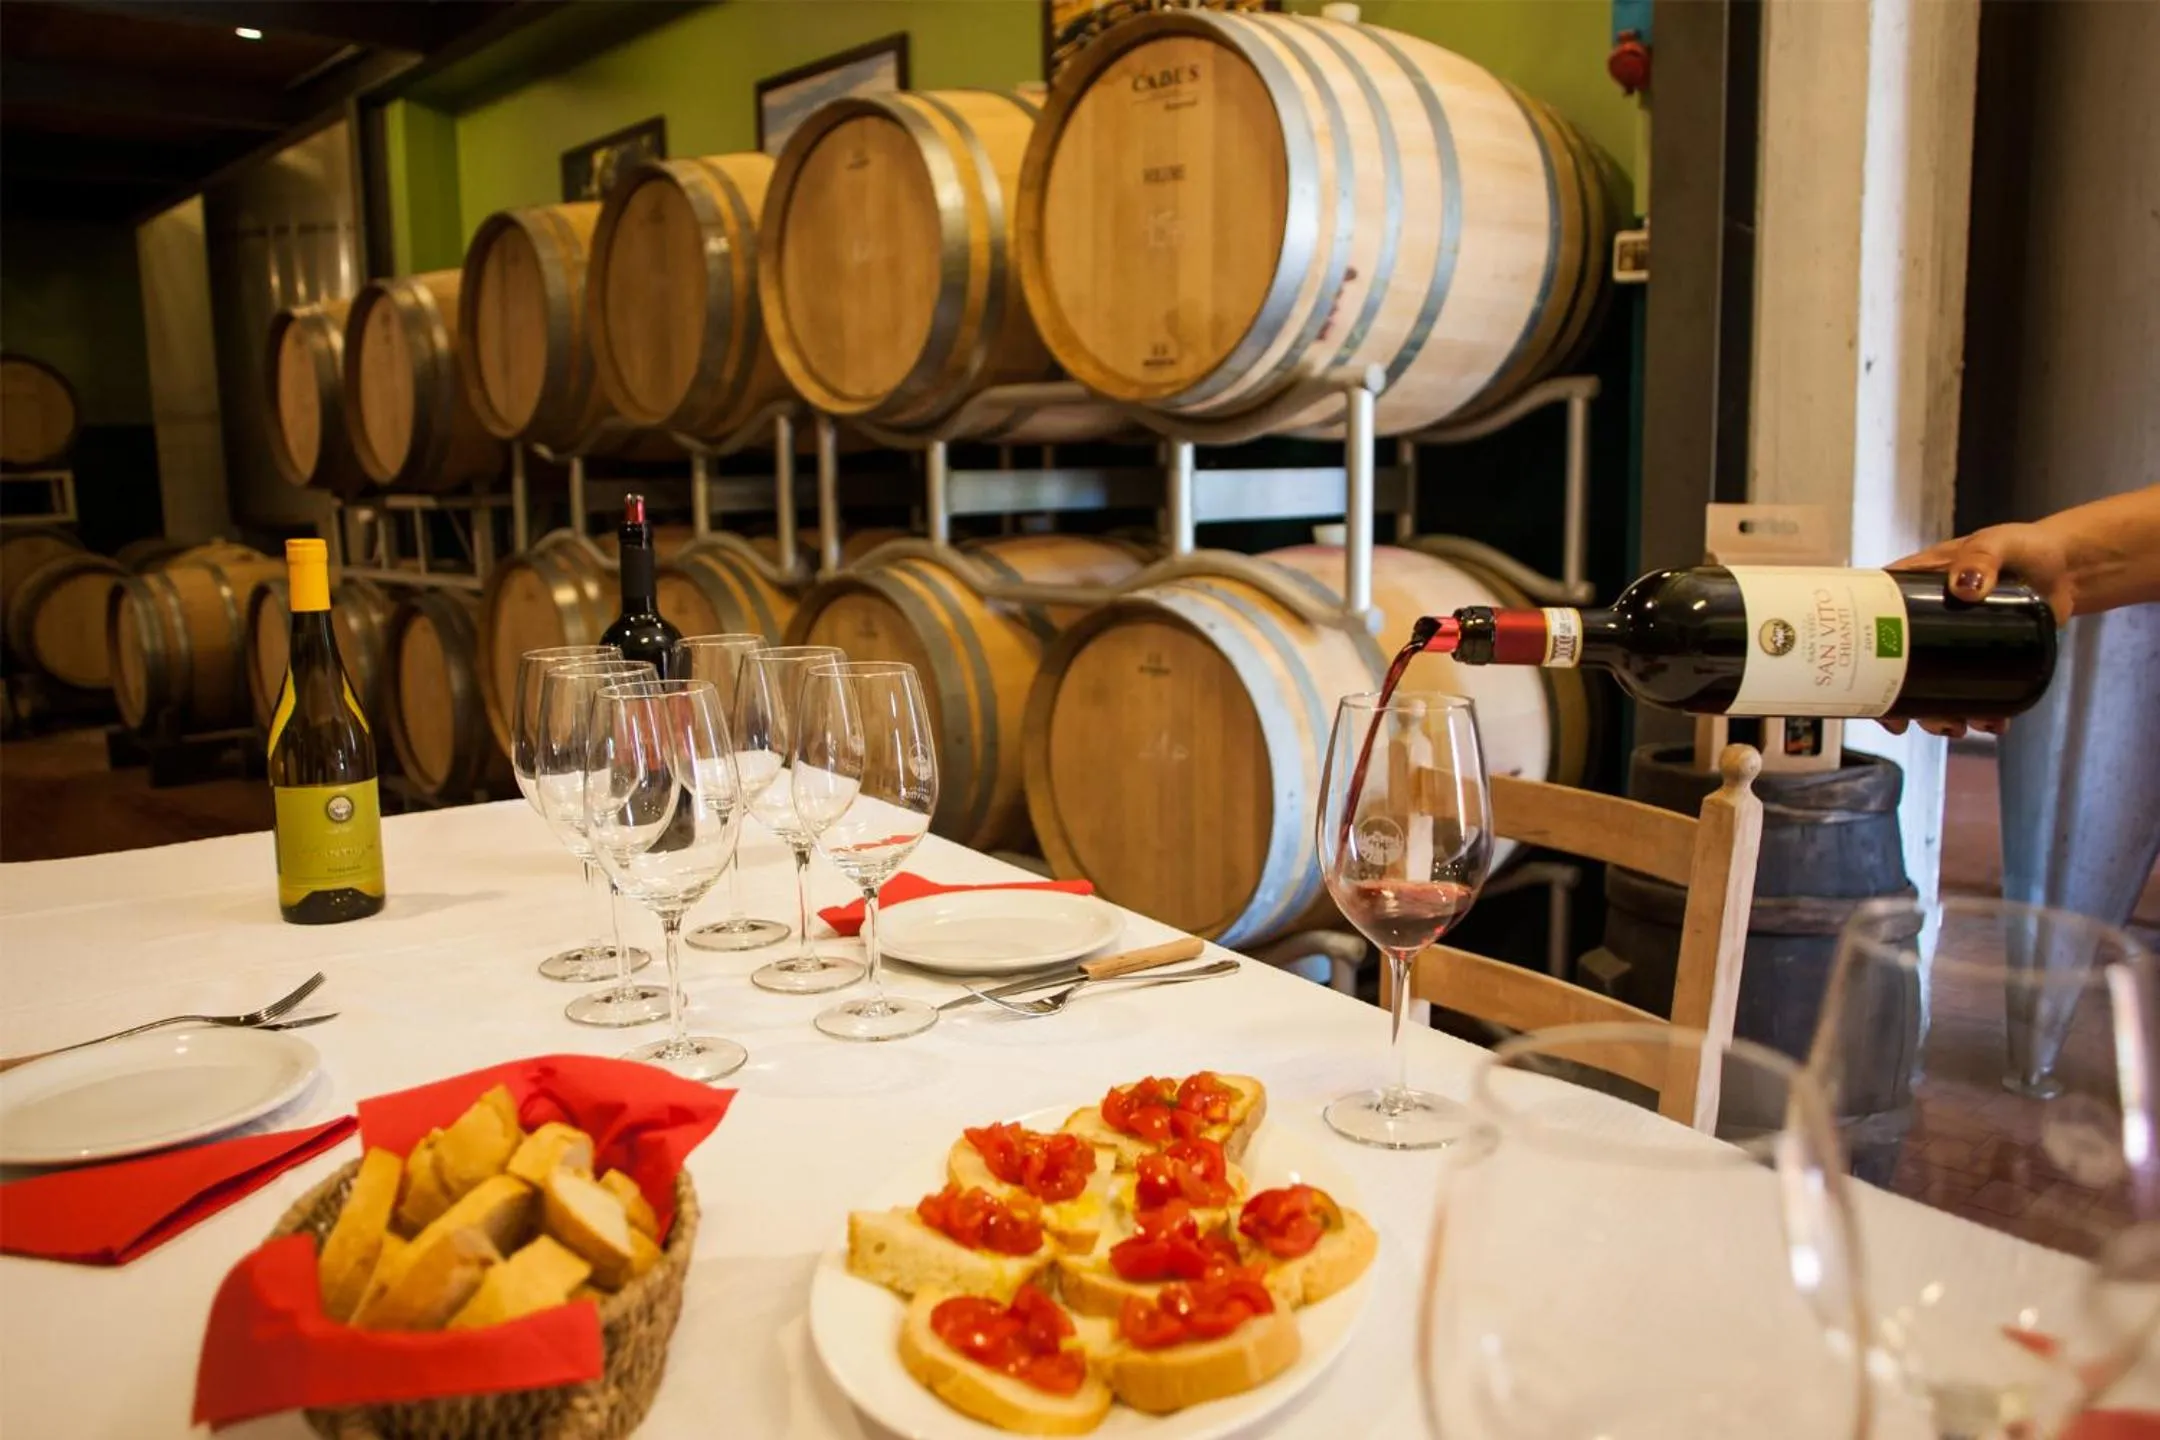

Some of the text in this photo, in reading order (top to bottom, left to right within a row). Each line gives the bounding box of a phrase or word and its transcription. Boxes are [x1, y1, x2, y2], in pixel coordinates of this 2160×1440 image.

[1812, 589, 1837, 687] SAN VITO
[1837, 608, 1853, 668] CHIANTI
